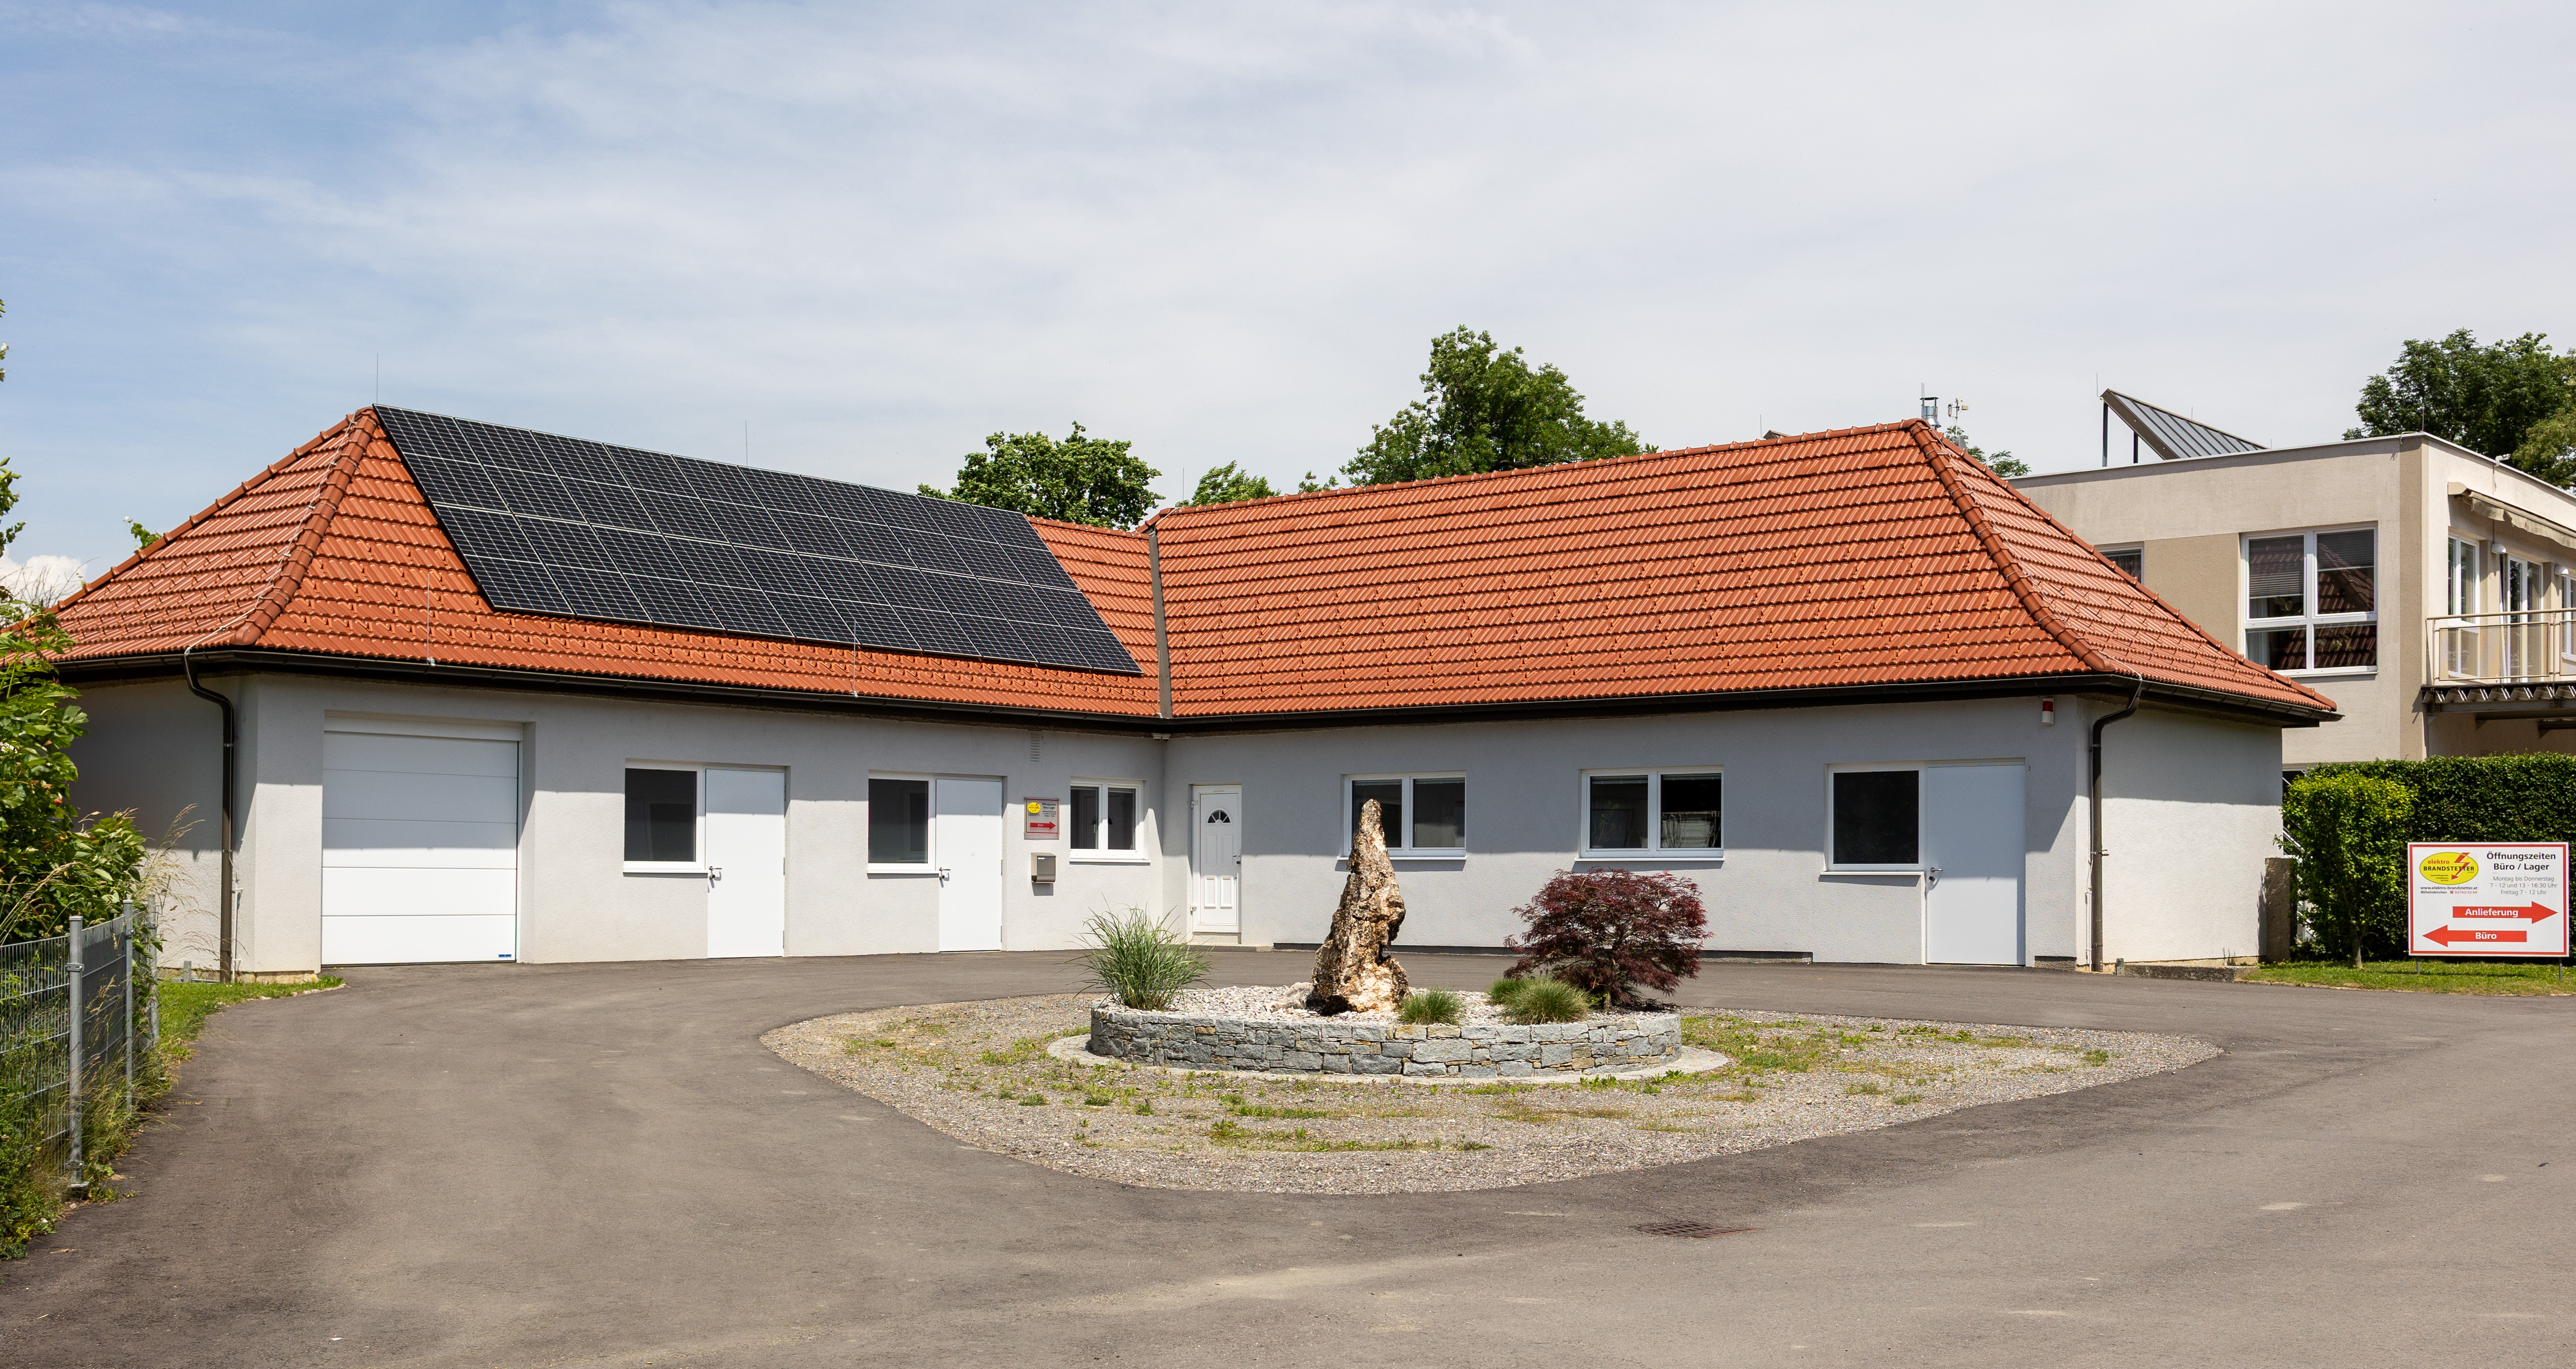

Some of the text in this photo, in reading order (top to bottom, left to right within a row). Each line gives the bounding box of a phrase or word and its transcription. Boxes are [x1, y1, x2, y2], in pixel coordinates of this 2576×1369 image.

[2487, 851, 2556, 862] Öffnungszeiten
[2524, 863, 2550, 872] Lager
[2465, 908, 2519, 918] Anlieferung
